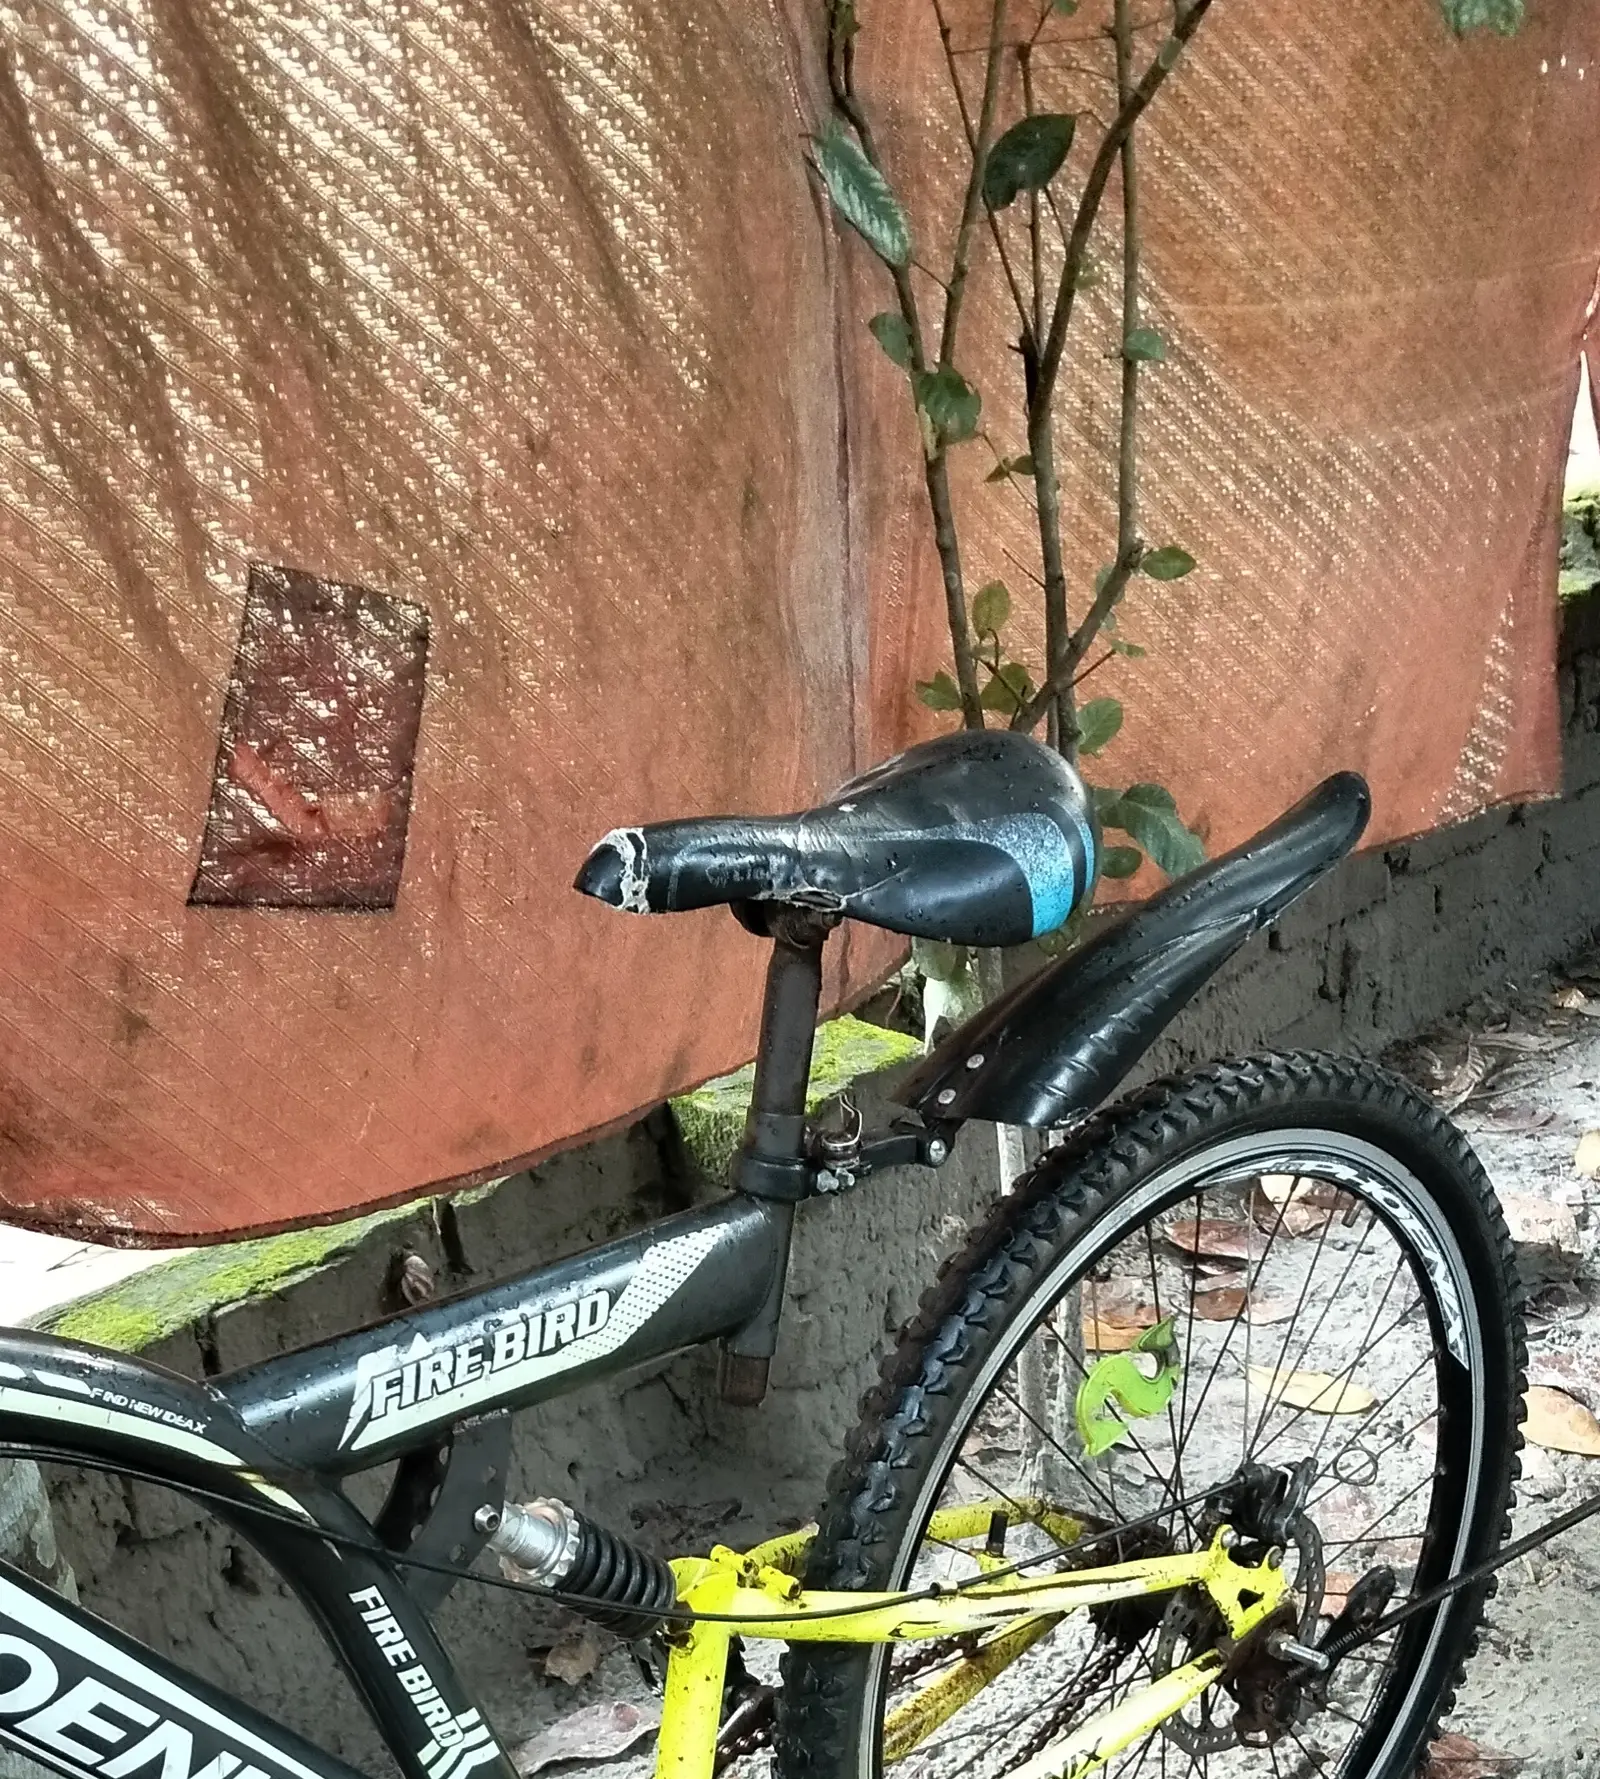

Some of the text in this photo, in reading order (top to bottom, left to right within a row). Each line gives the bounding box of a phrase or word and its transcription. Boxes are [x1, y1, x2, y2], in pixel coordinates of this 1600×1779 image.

[90, 1387, 128, 1407] FIND
[128, 1399, 164, 1418] NEW
[369, 1289, 611, 1421] FIRE BIRD
[348, 1584, 466, 1749] FIRE BIRD
